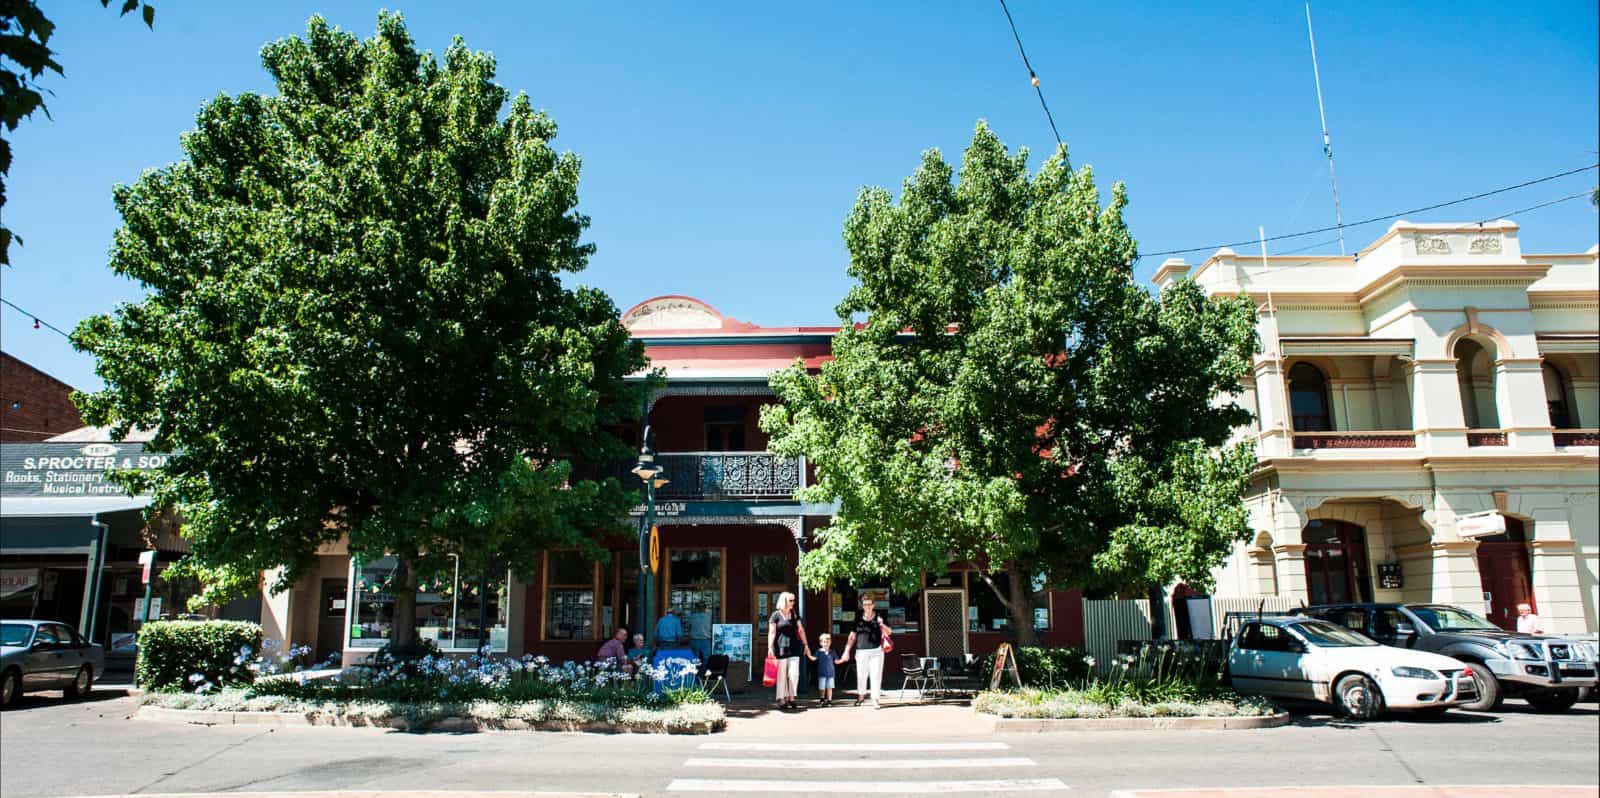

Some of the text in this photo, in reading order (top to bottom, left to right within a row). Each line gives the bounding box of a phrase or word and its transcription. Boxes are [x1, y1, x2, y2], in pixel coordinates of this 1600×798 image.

[122, 458, 132, 469] &
[46, 471, 104, 483] Stationery
[43, 483, 85, 494] Musical
